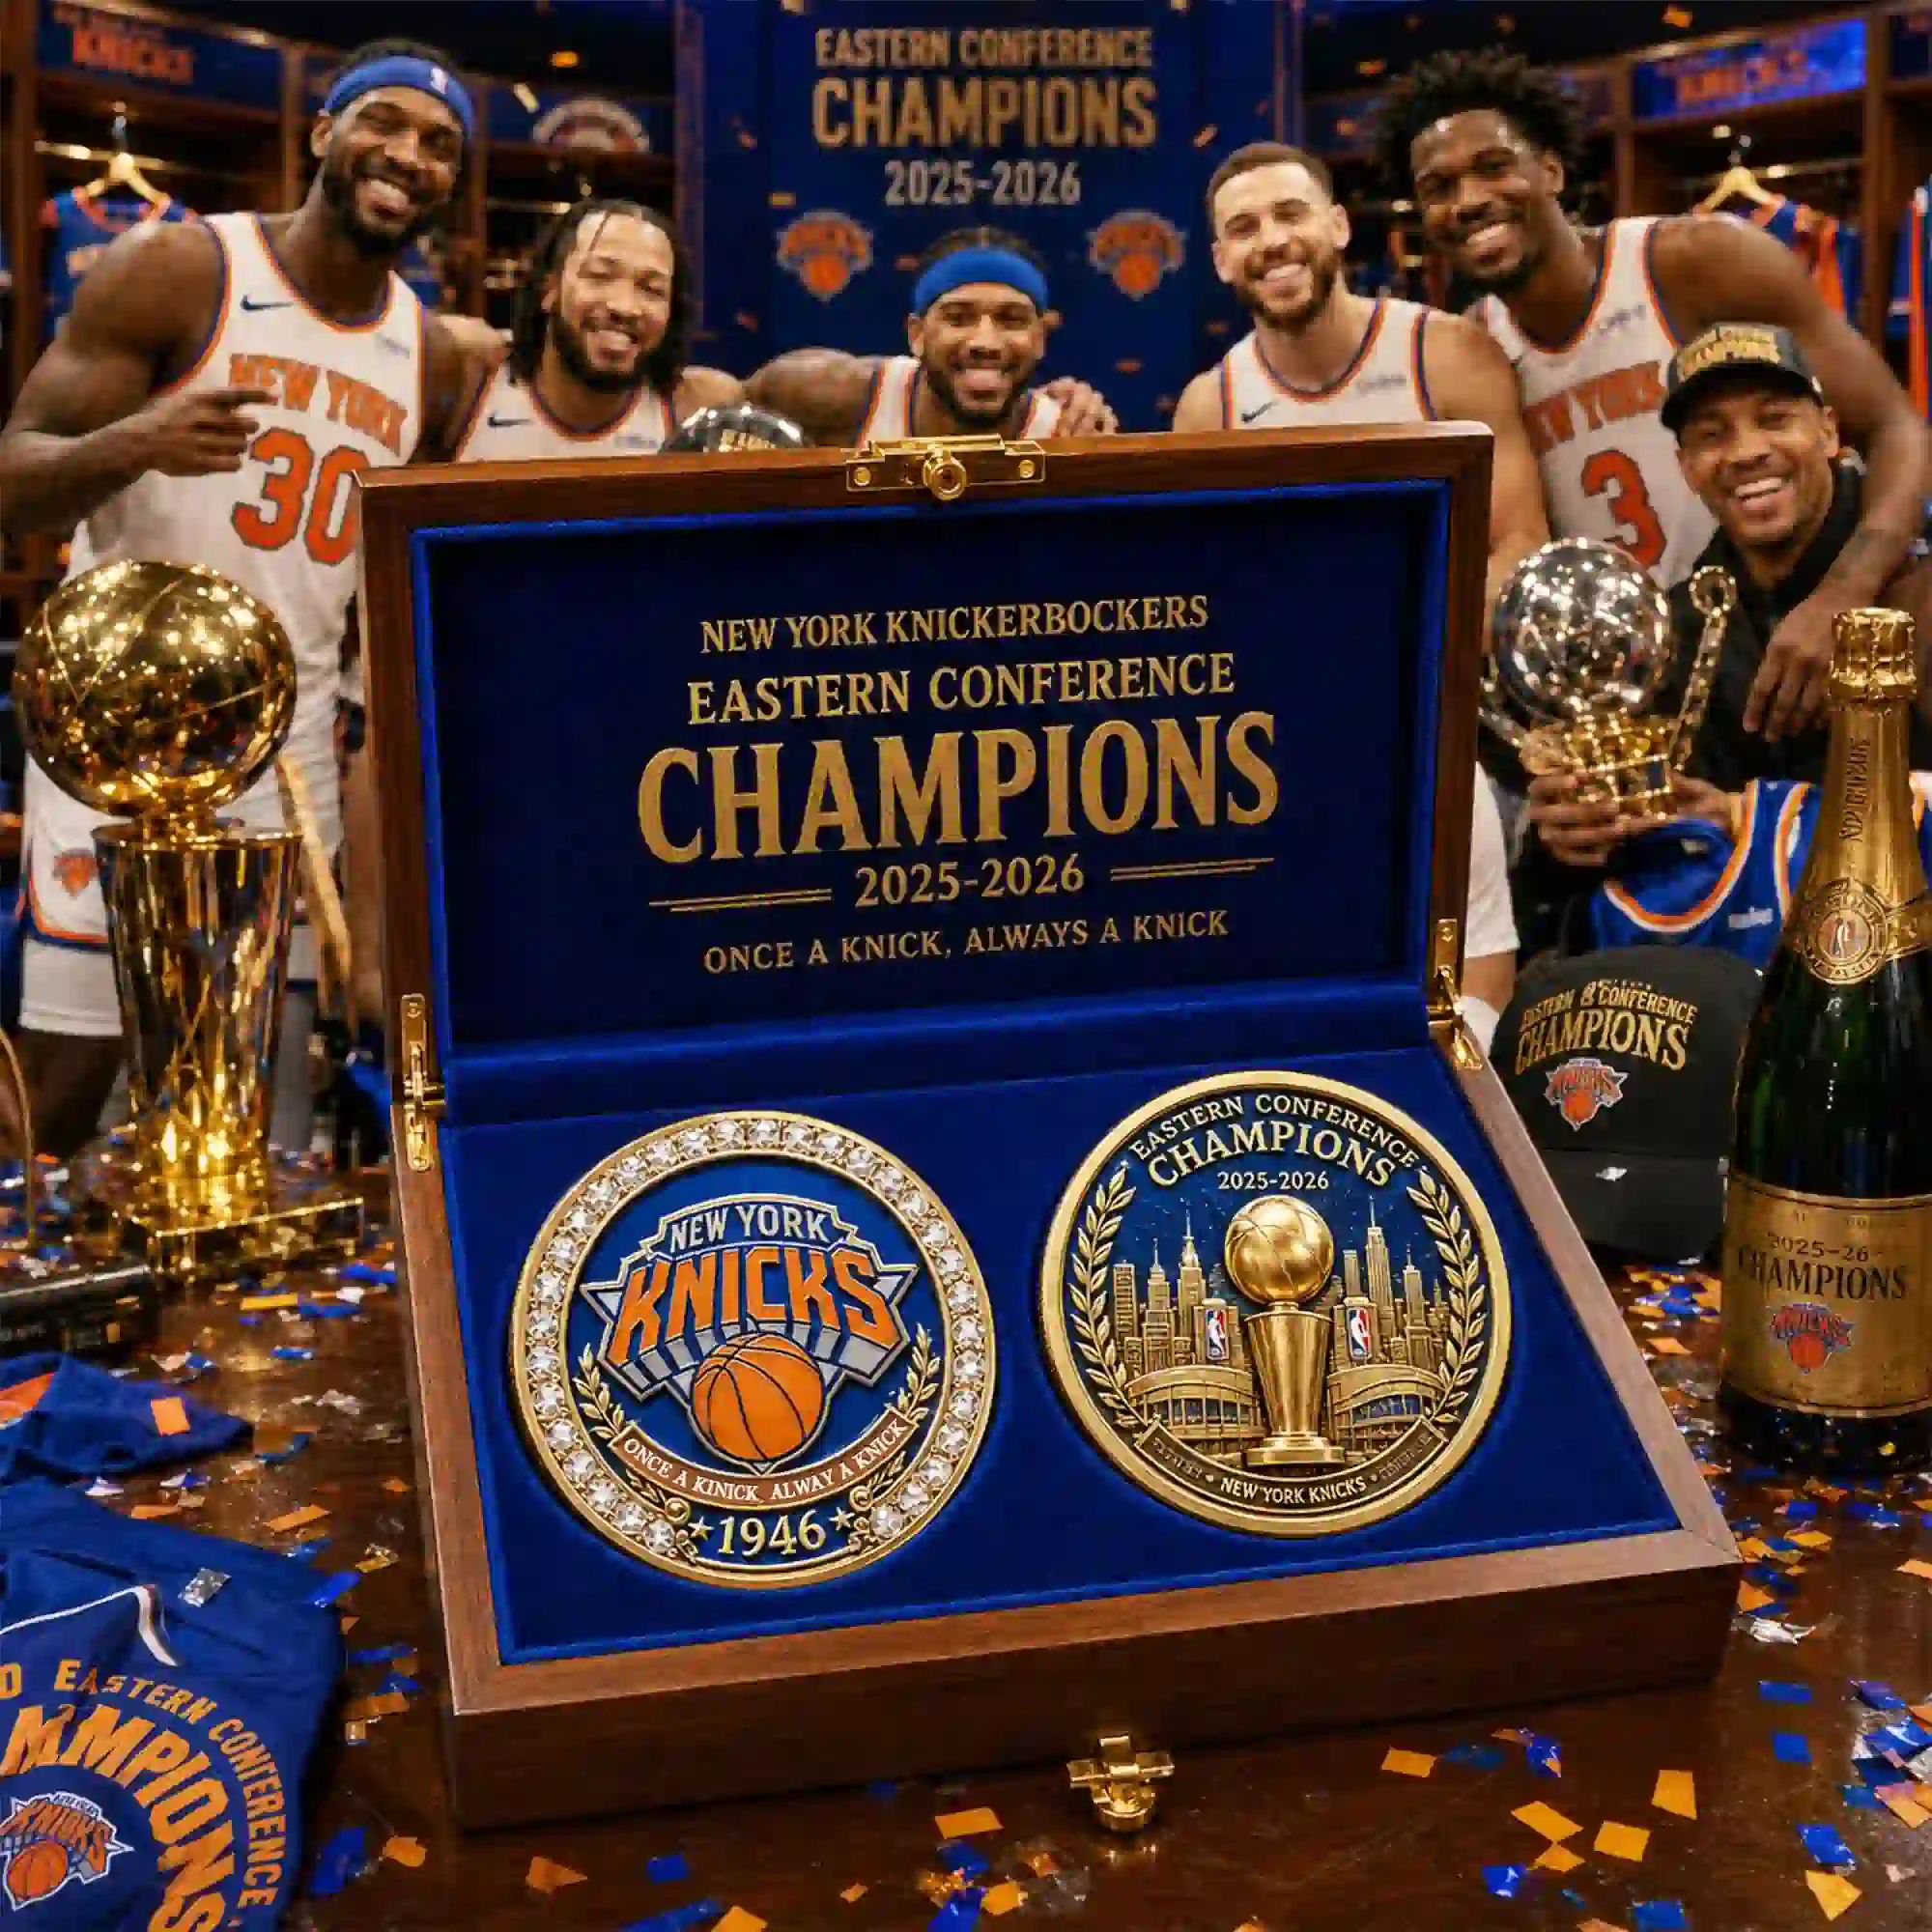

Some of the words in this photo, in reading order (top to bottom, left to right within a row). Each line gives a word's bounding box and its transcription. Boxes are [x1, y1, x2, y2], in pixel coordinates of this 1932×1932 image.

[815, 28, 951, 68] EASTERN
[959, 28, 1152, 69] CONFERENCE
[812, 76, 1157, 147] CHAMPIONS
[885, 159, 1081, 206] 2025-2026
[229, 354, 319, 412] NEW
[326, 369, 409, 457] YORK
[231, 426, 371, 566] 30
[1580, 449, 1667, 567] 3
[699, 616, 780, 654] NEW
[784, 611, 875, 651] YORK
[886, 594, 1208, 645] KNICKERBOCKERS
[688, 668, 911, 725] EASTERN
[929, 652, 1236, 709] CONFERENCE
[638, 711, 1280, 865] CHAMPIONS
[855, 853, 1085, 907] 2025-2026
[704, 941, 794, 974] ONCE
[807, 938, 829, 965] A
[841, 931, 952, 961] KNICK,
[964, 920, 1089, 954] ALWAYS
[1099, 918, 1122, 943] A
[1132, 910, 1230, 941] KNICK
[1515, 1008, 1690, 1076] CHAMPIONS
[1129, 1095, 1244, 1160] EASTERN
[1255, 1094, 1419, 1167] CONFERENCE
[1147, 1120, 1396, 1188] CHAMPIONS
[1217, 1172, 1329, 1191] 2025-2026
[669, 1208, 727, 1253] NEW
[741, 1205, 830, 1244] YORK
[1738, 1244, 1908, 1300] CHAMPIONS
[608, 1247, 902, 1366] KNICKS
[623, 1437, 673, 1479] ONCE
[673, 1471, 689, 1490] A
[771, 1470, 835, 1500] ALWAY
[838, 1462, 855, 1481] A
[852, 1417, 907, 1468] KNICK
[1220, 1476, 1259, 1500] NEW
[1263, 1485, 1306, 1505] YORK
[1309, 1475, 1367, 1505] KNICKS
[718, 1508, 827, 1557] 1946
[54, 1659, 217, 1725] EASTERN
